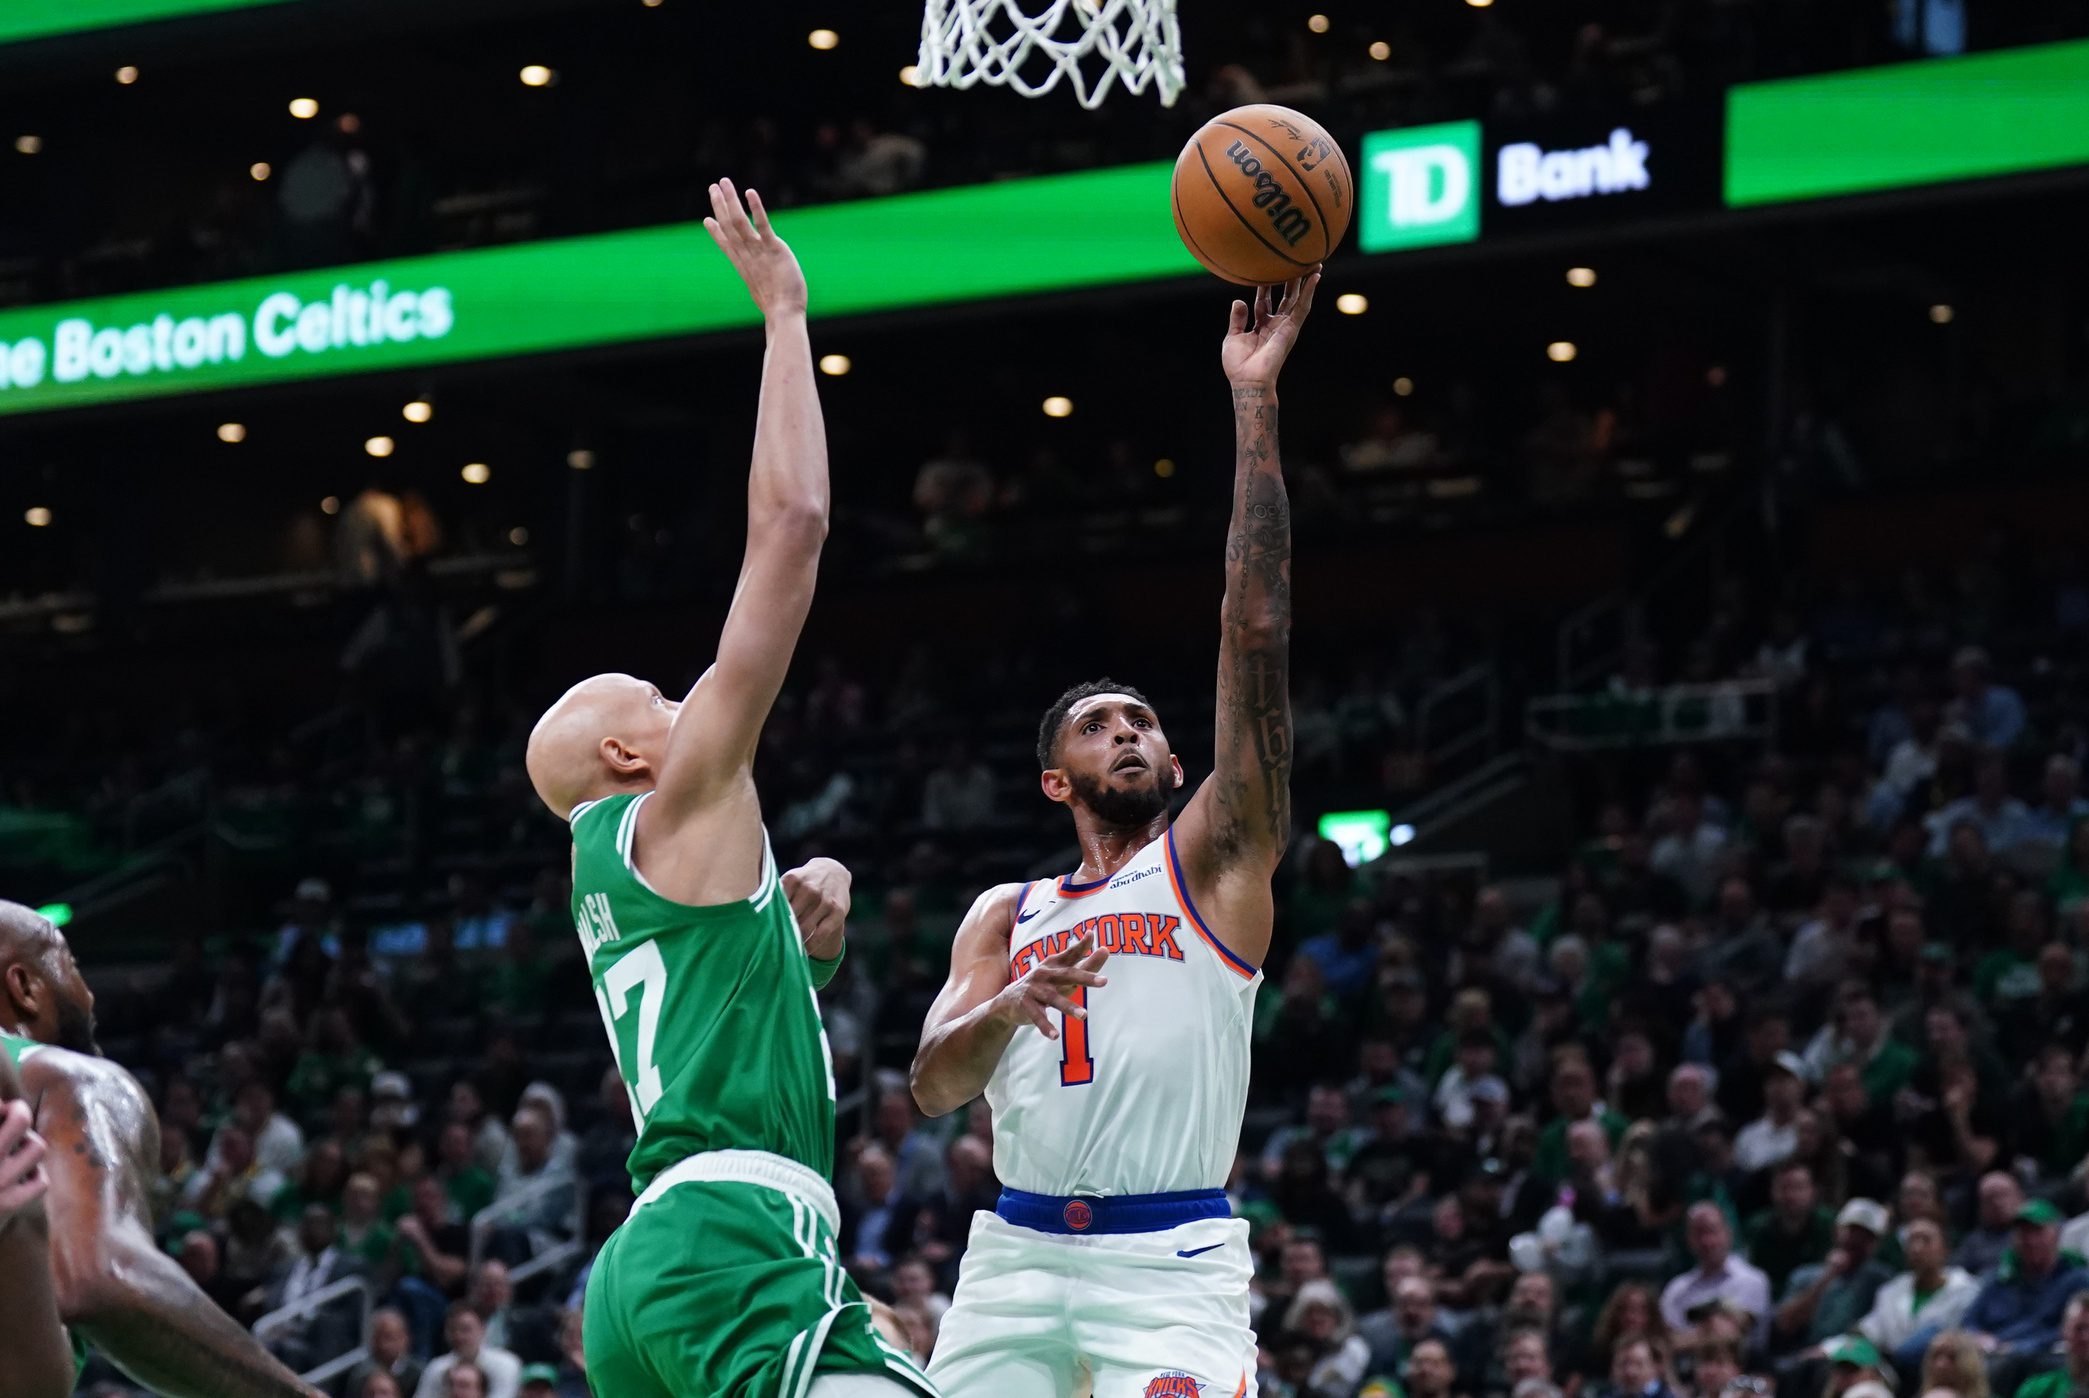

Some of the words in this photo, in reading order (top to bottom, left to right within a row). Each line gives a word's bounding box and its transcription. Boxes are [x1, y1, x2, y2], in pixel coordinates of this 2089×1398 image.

[1225, 139, 1313, 247] Wilson
[1371, 144, 1470, 228] TD
[1497, 127, 1651, 207] Bank
[53, 312, 246, 383] Boston
[253, 279, 454, 357] Celtics
[1110, 879, 1130, 889] abu
[1131, 863, 1162, 882] dhabi
